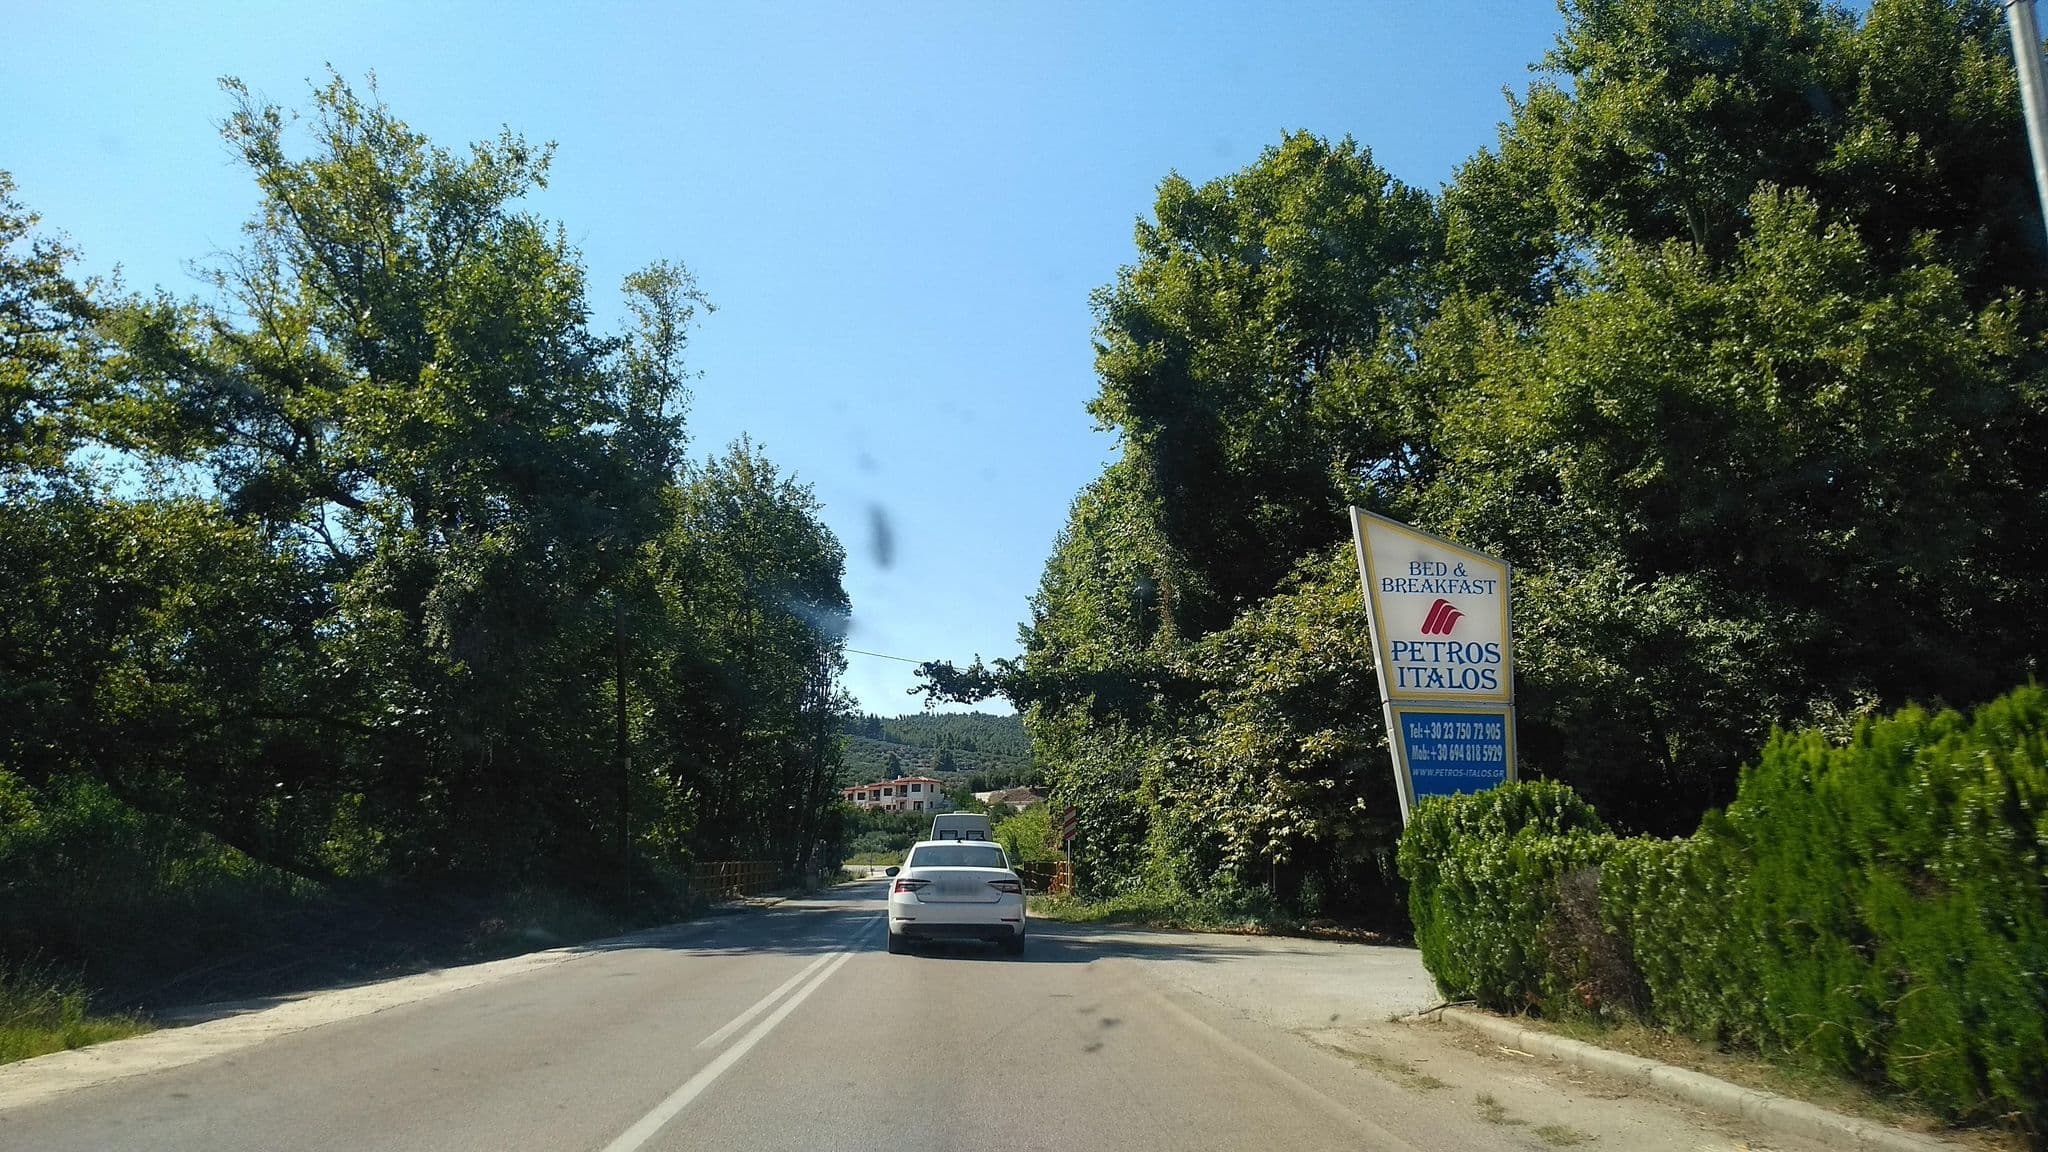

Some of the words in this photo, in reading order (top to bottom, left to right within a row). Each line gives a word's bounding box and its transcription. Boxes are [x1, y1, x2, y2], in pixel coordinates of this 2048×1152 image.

[1410, 561, 1447, 576] BED
[1453, 562, 1468, 577] &
[1382, 578, 1496, 594] BREAKFAST
[1392, 641, 1501, 665] PETROS
[1398, 667, 1497, 690] ITALOS
[1443, 722, 1454, 739] 23
[1456, 722, 1471, 739] 750
[1473, 723, 1483, 740] 72
[1486, 723, 1500, 740] 905
[1450, 744, 1464, 761] 694
[1466, 744, 1481, 761] 818
[1483, 745, 1502, 762] 5929
[1412, 768, 1505, 777] WWW.PETROS-ITALOS.GR
